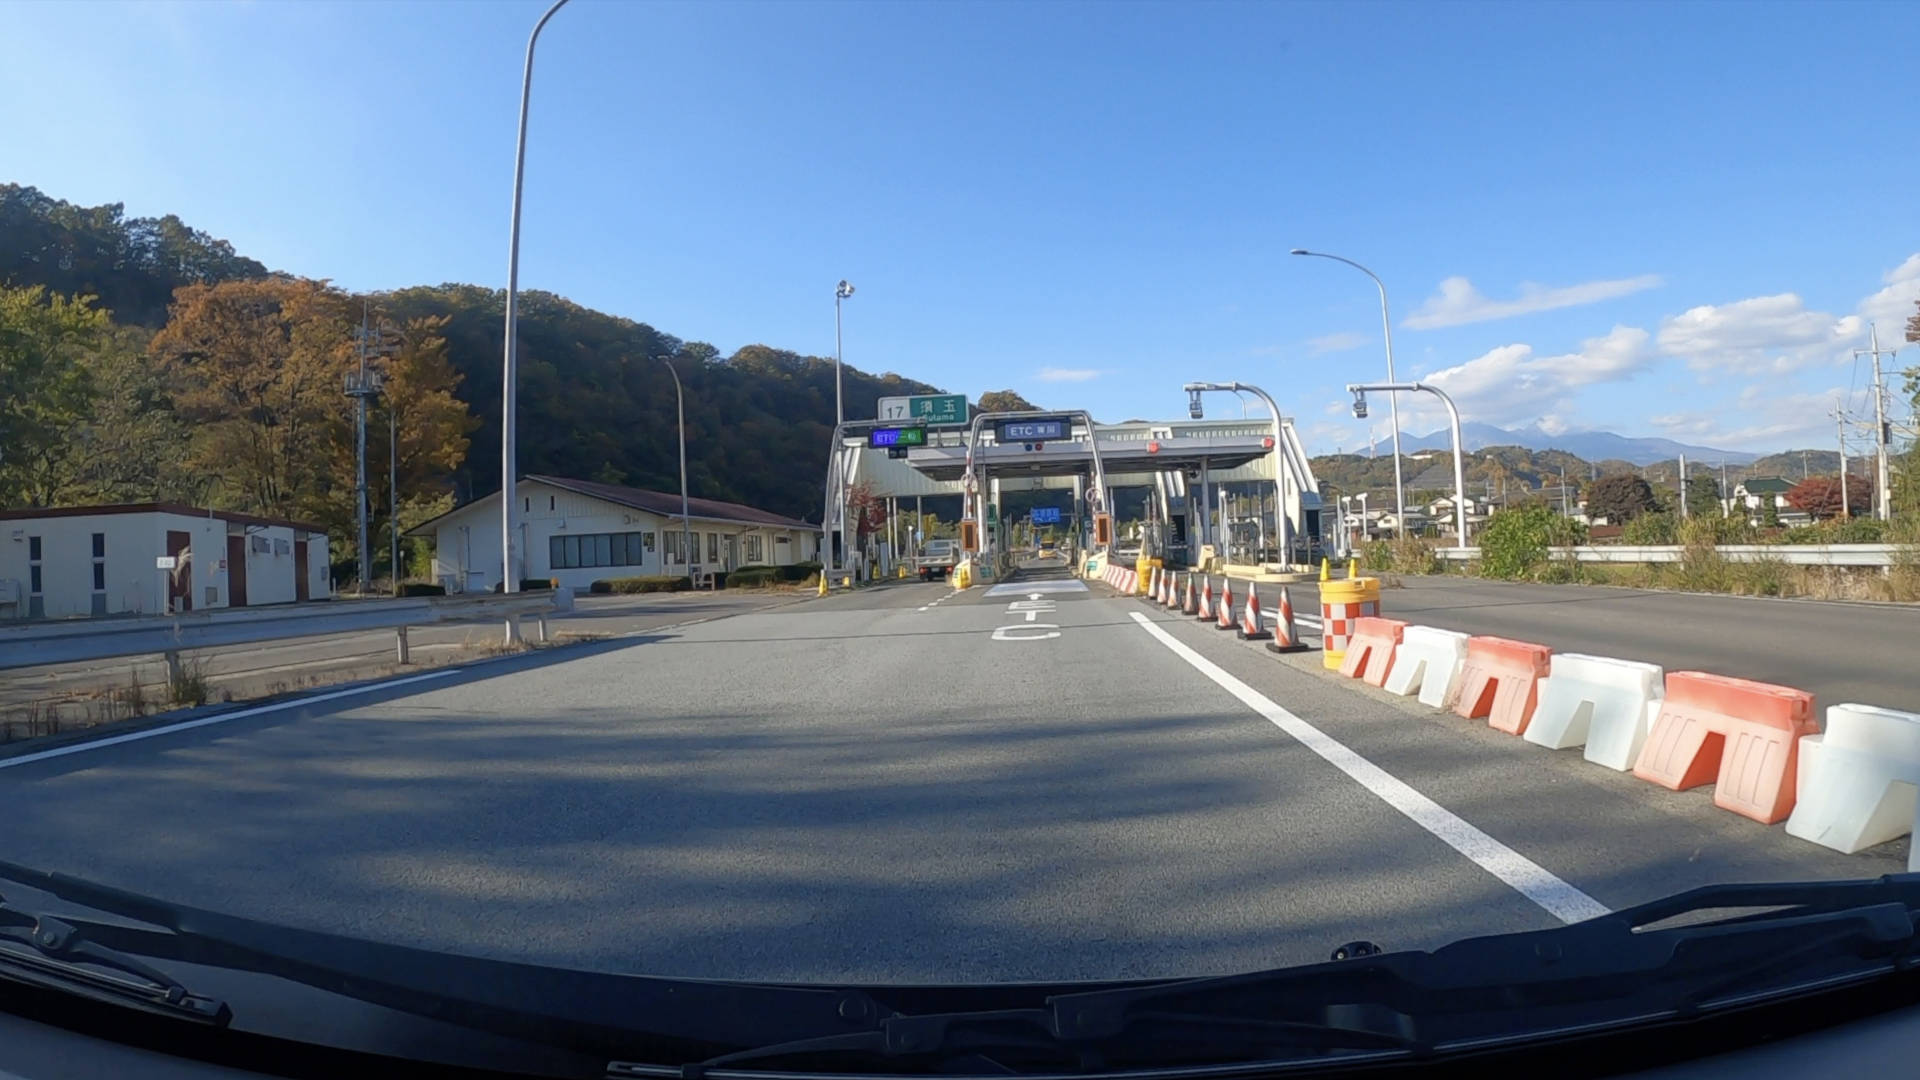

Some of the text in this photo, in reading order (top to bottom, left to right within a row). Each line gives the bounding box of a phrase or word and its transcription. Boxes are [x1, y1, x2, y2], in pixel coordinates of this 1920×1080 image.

[888, 406, 904, 418] 17
[919, 400, 956, 413] 須玉
[1010, 426, 1033, 436] ETC
[877, 433, 895, 443] ETC
